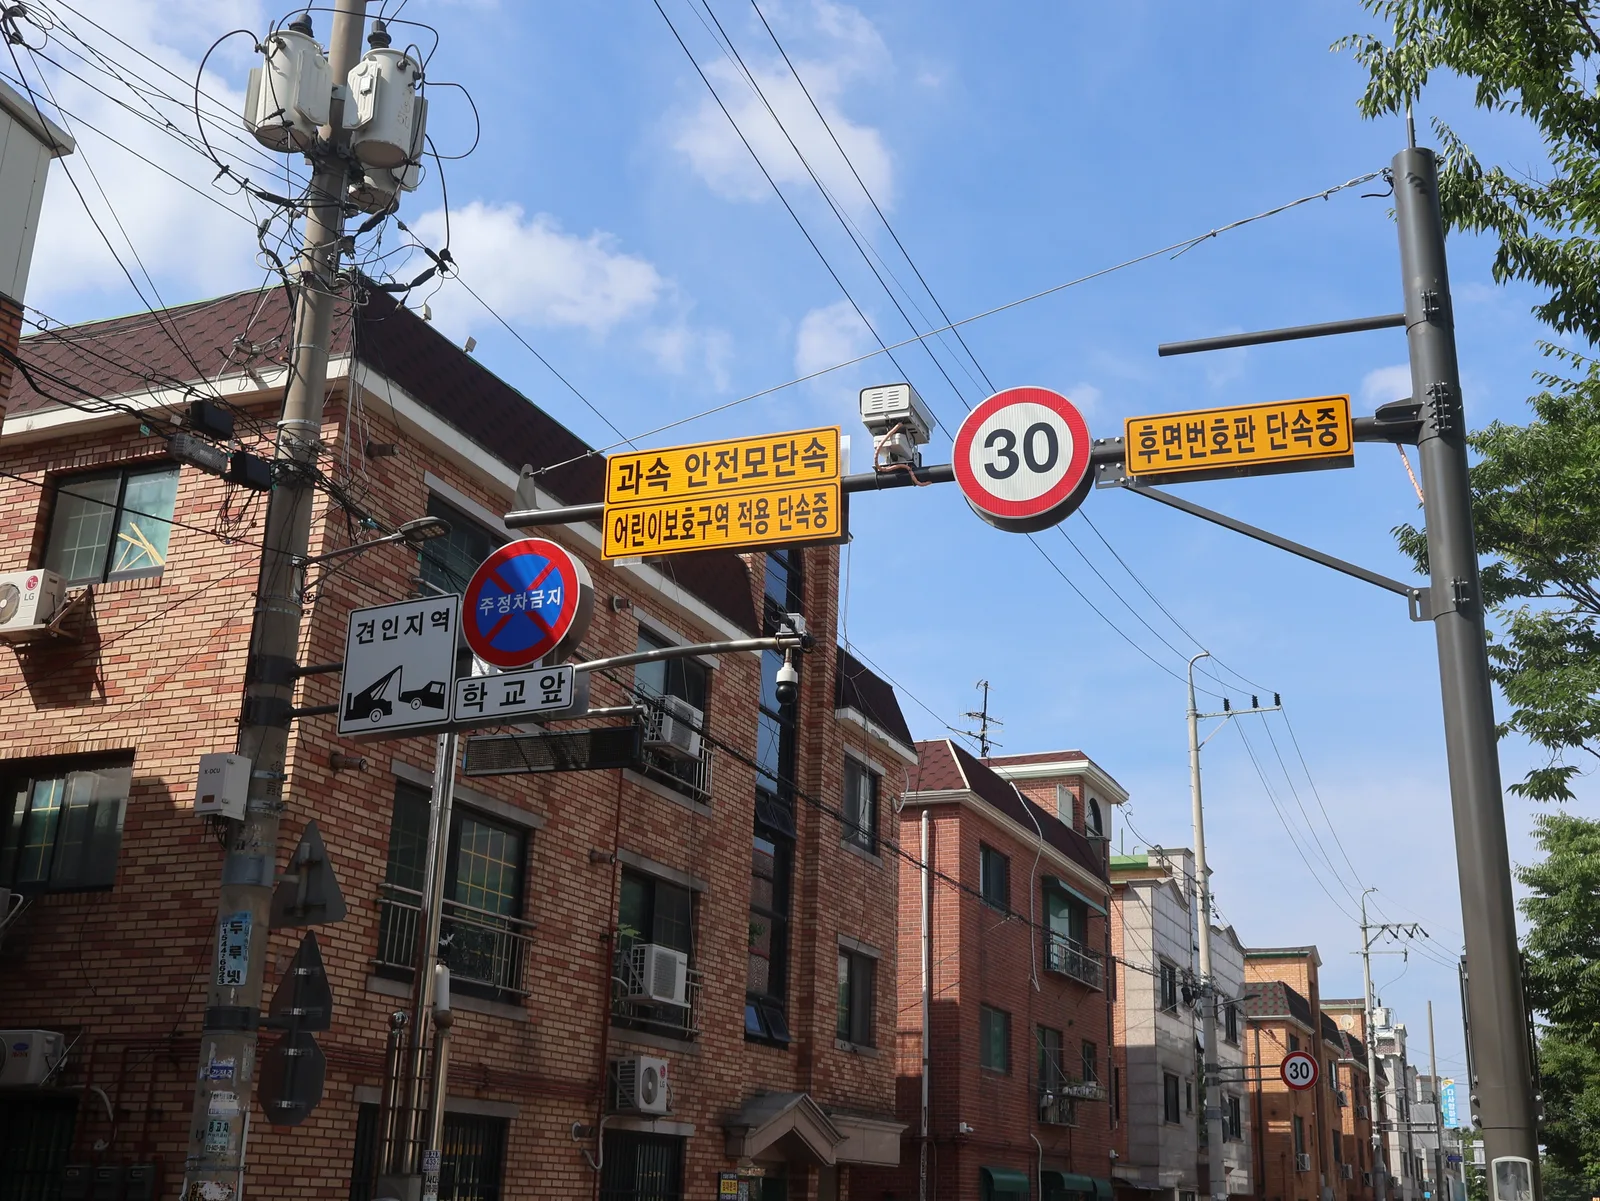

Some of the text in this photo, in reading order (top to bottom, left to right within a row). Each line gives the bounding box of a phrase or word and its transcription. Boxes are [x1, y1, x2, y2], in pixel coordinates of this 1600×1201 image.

[984, 422, 1059, 480] 30
[1138, 407, 1339, 464] 후면번호판 단속중
[616, 437, 828, 495] 과속 안전모단속
[614, 492, 828, 549] 어린이보호구역 적용 단속중
[24, 593, 34, 601] LG
[479, 586, 562, 616] 주정차금지
[355, 608, 450, 645] 견인지역
[1289, 1062, 1309, 1080] 30
